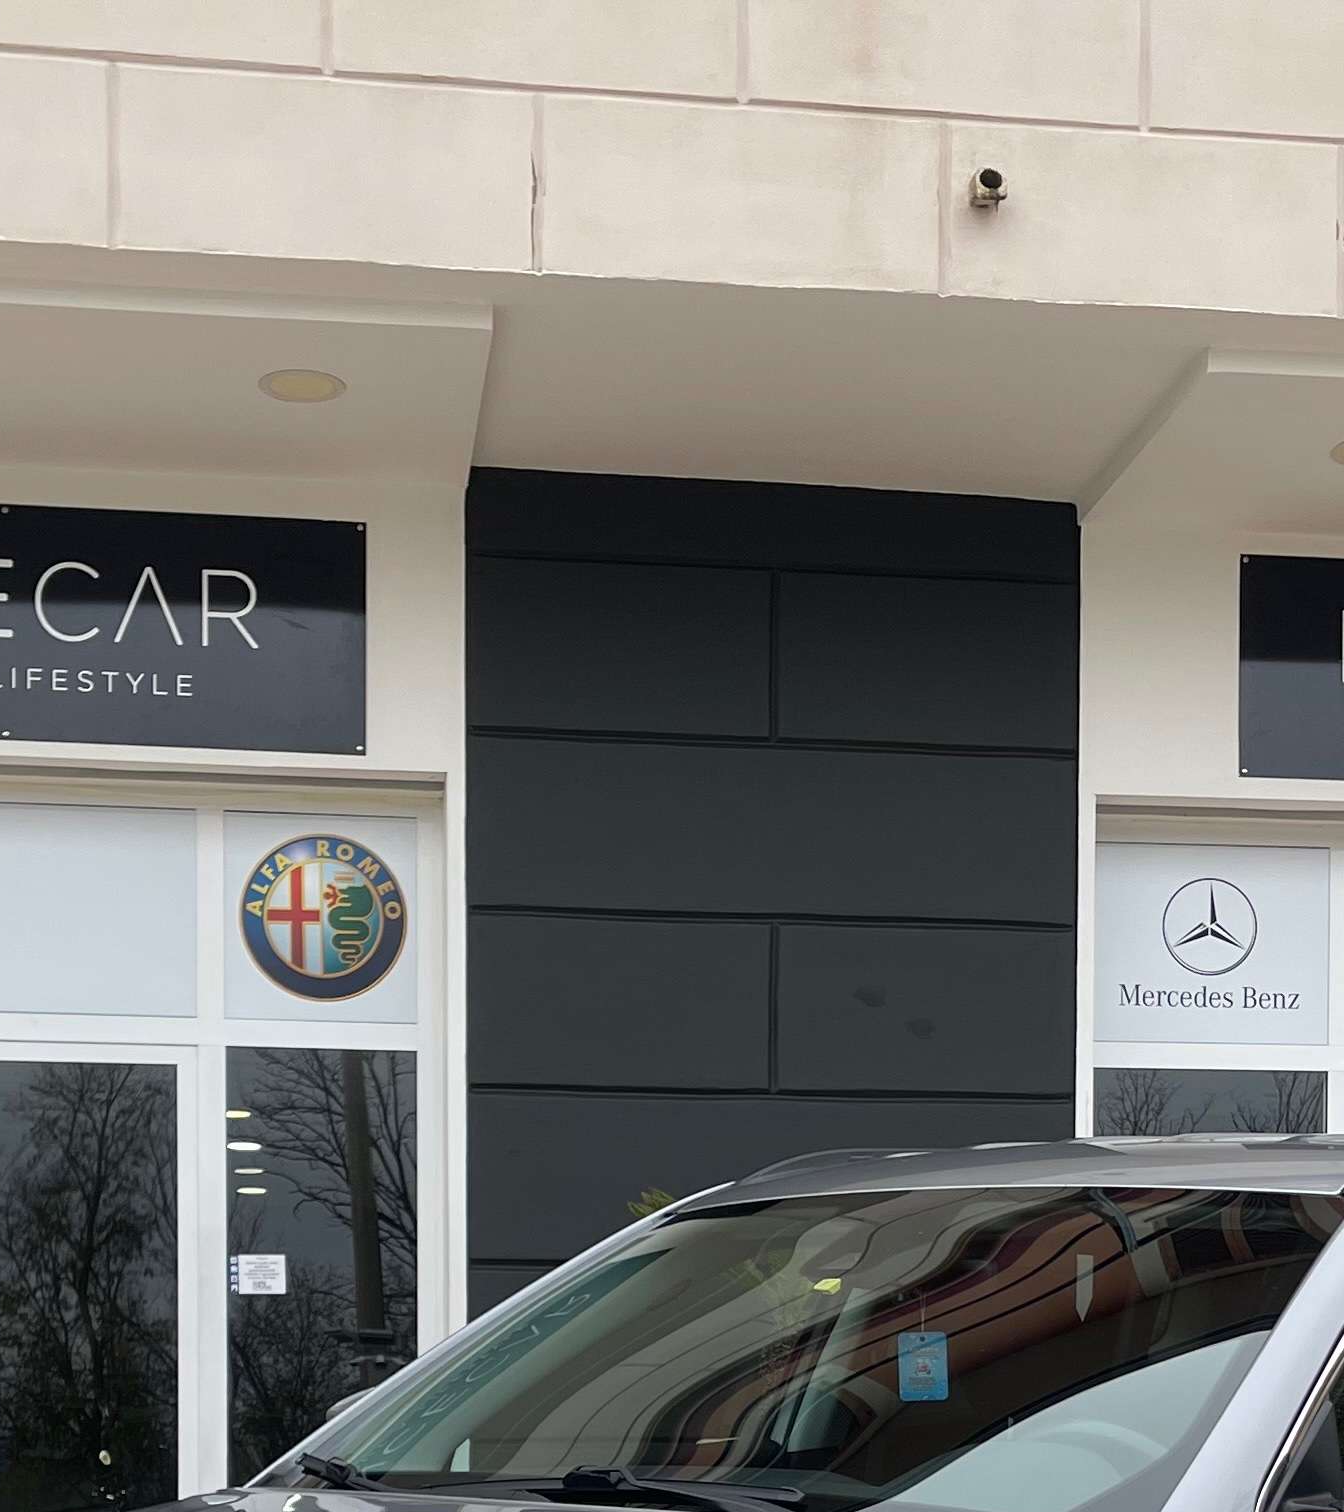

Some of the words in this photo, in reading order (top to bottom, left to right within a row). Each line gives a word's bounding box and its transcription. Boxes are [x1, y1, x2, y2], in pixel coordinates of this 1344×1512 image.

[245, 852, 293, 918] ALFA
[315, 839, 402, 921] ROMEO
[1119, 983, 1234, 1009] Mercedes
[1242, 986, 1300, 1010] Benz
